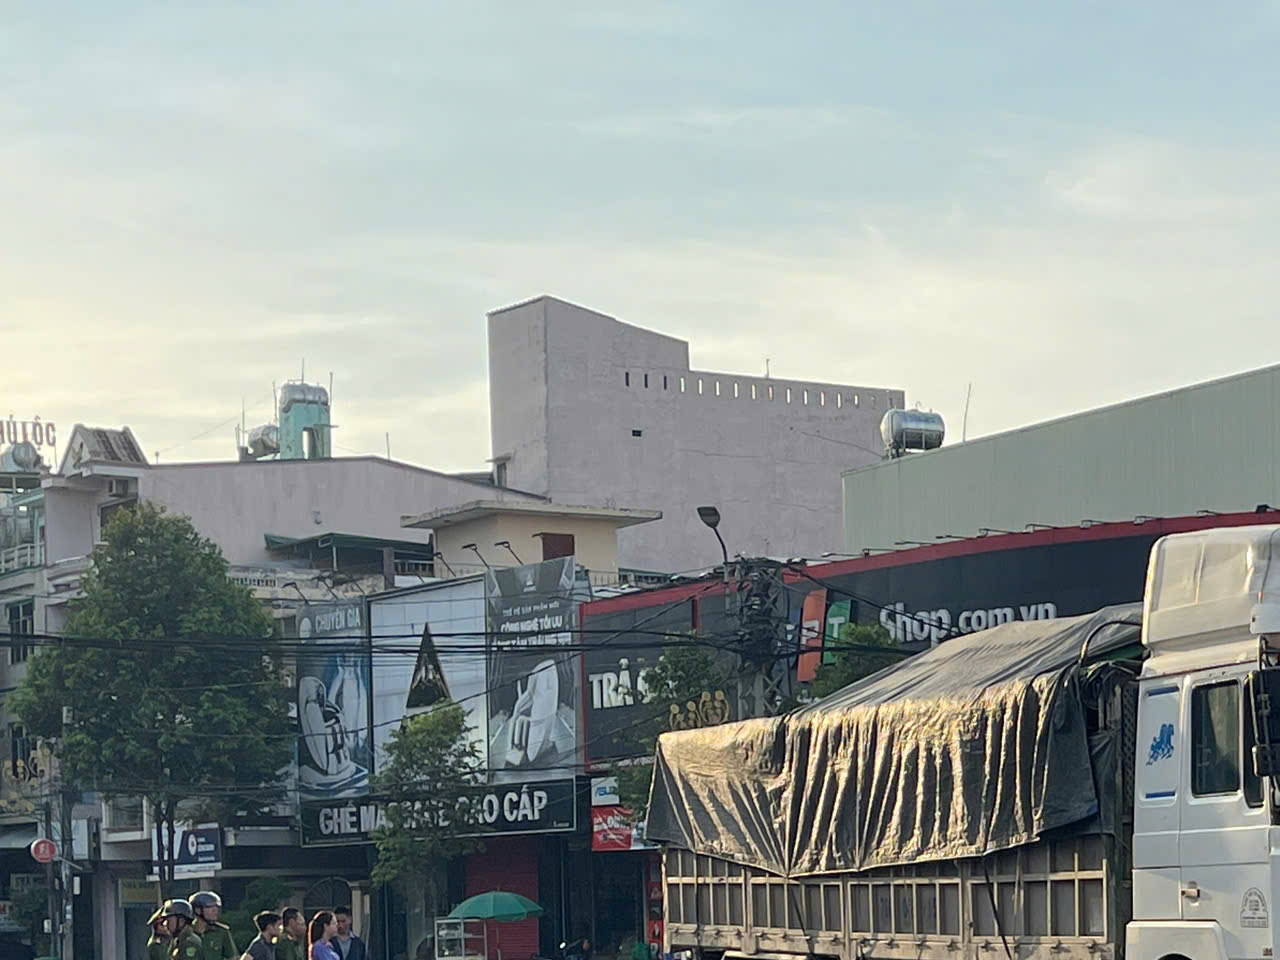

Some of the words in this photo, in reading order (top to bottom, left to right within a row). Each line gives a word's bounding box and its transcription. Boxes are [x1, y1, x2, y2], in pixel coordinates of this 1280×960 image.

[879, 602, 1057, 648] Shop.com.vn
[588, 658, 634, 709] TRẢ
[503, 784, 548, 823] CẤP
